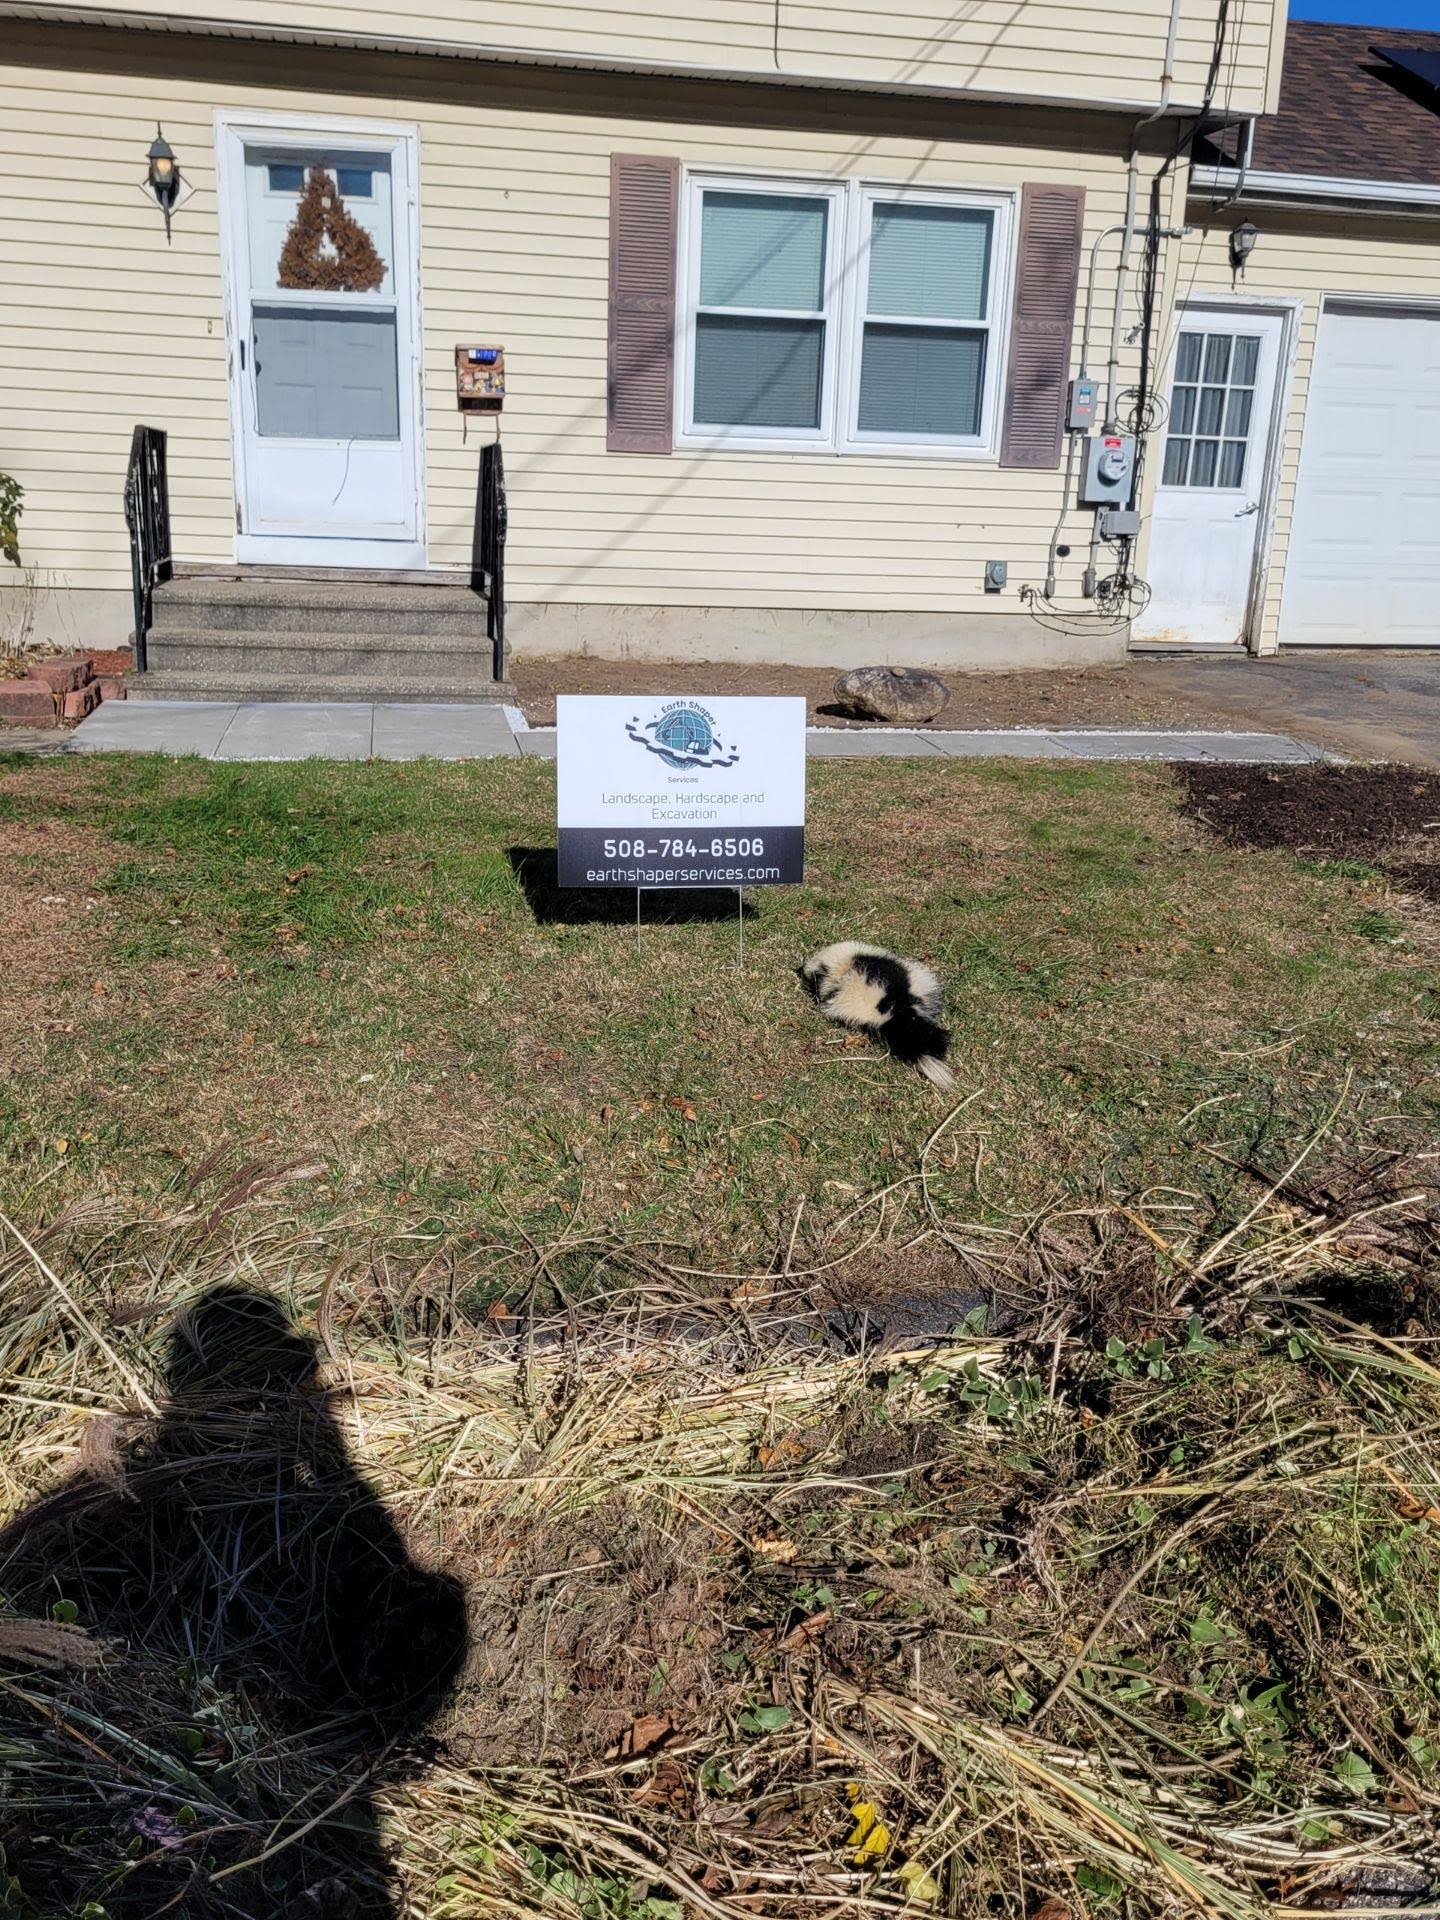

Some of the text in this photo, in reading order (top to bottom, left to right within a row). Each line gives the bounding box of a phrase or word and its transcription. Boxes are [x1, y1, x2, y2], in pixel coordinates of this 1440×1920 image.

[661, 700, 716, 726] Earth Shaper
[667, 776, 700, 784] Services
[675, 793, 739, 806] Hardscape
[742, 792, 765, 804] and
[651, 808, 718, 820] Excavation
[603, 838, 764, 858] 508-784-6506
[586, 866, 780, 884] earthshaperservices.com
